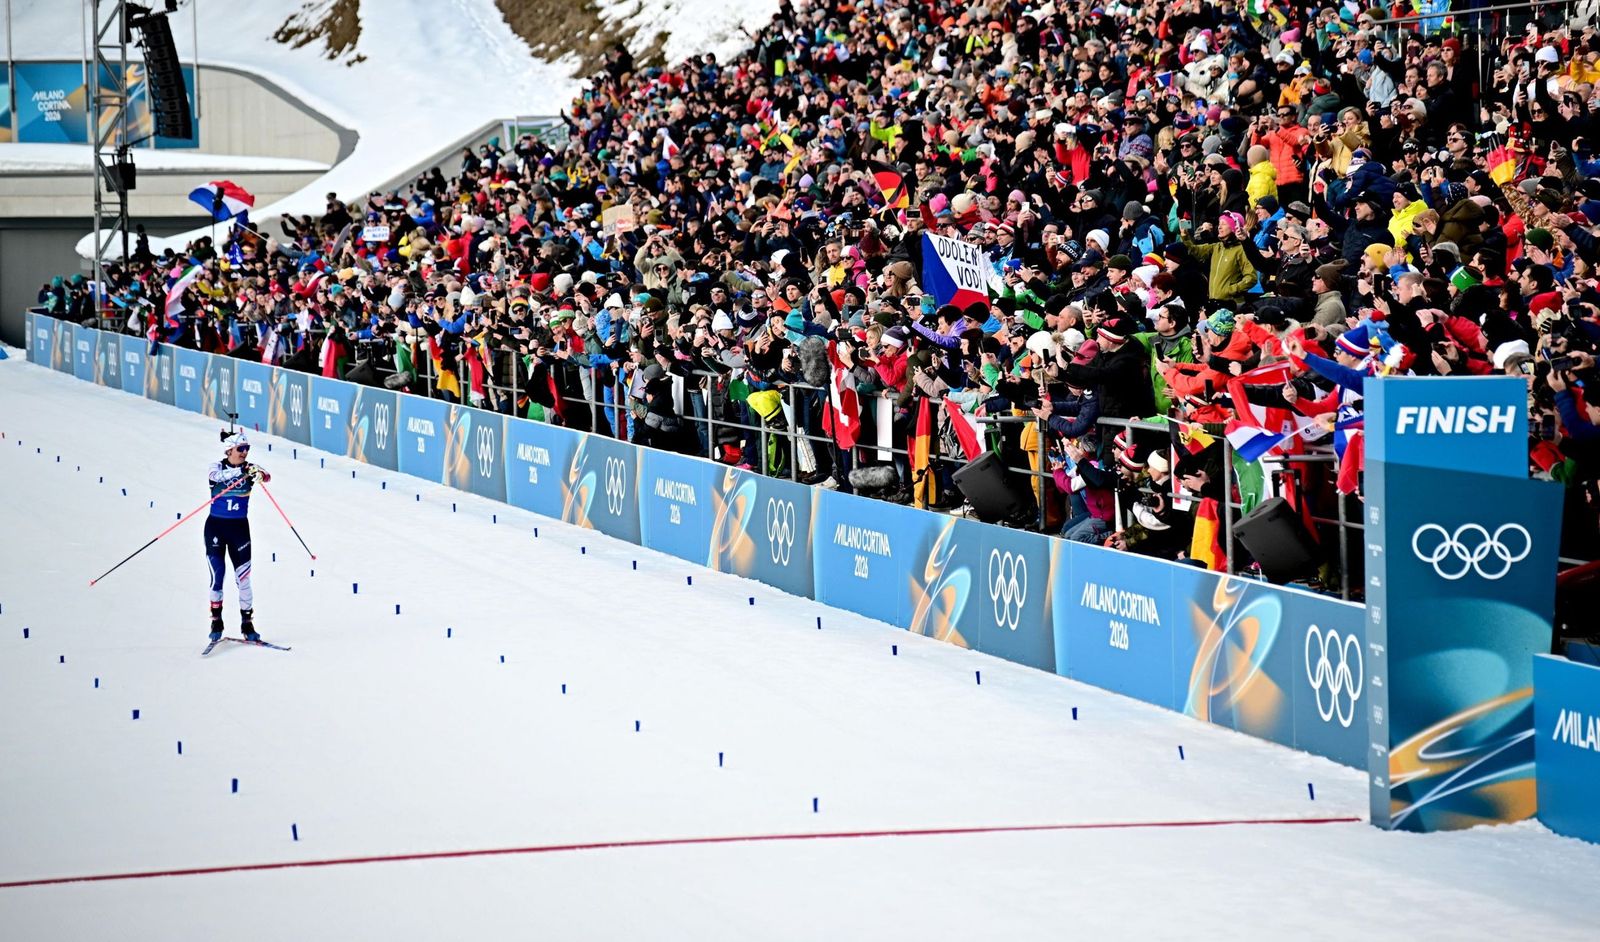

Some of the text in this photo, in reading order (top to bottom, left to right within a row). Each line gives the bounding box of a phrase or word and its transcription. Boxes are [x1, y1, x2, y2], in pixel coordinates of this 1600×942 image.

[32, 89, 65, 101] MILANO
[38, 100, 72, 111] CORTINA
[938, 237, 980, 267] ODOLEN
[1395, 405, 1517, 434] FINISH
[654, 477, 697, 506] MILANO CORTINA
[833, 522, 892, 558] MILANO CORTINA
[854, 553, 869, 579] 2026
[1080, 581, 1161, 627] MILANO CORTINA
[1109, 619, 1129, 651] 2026
